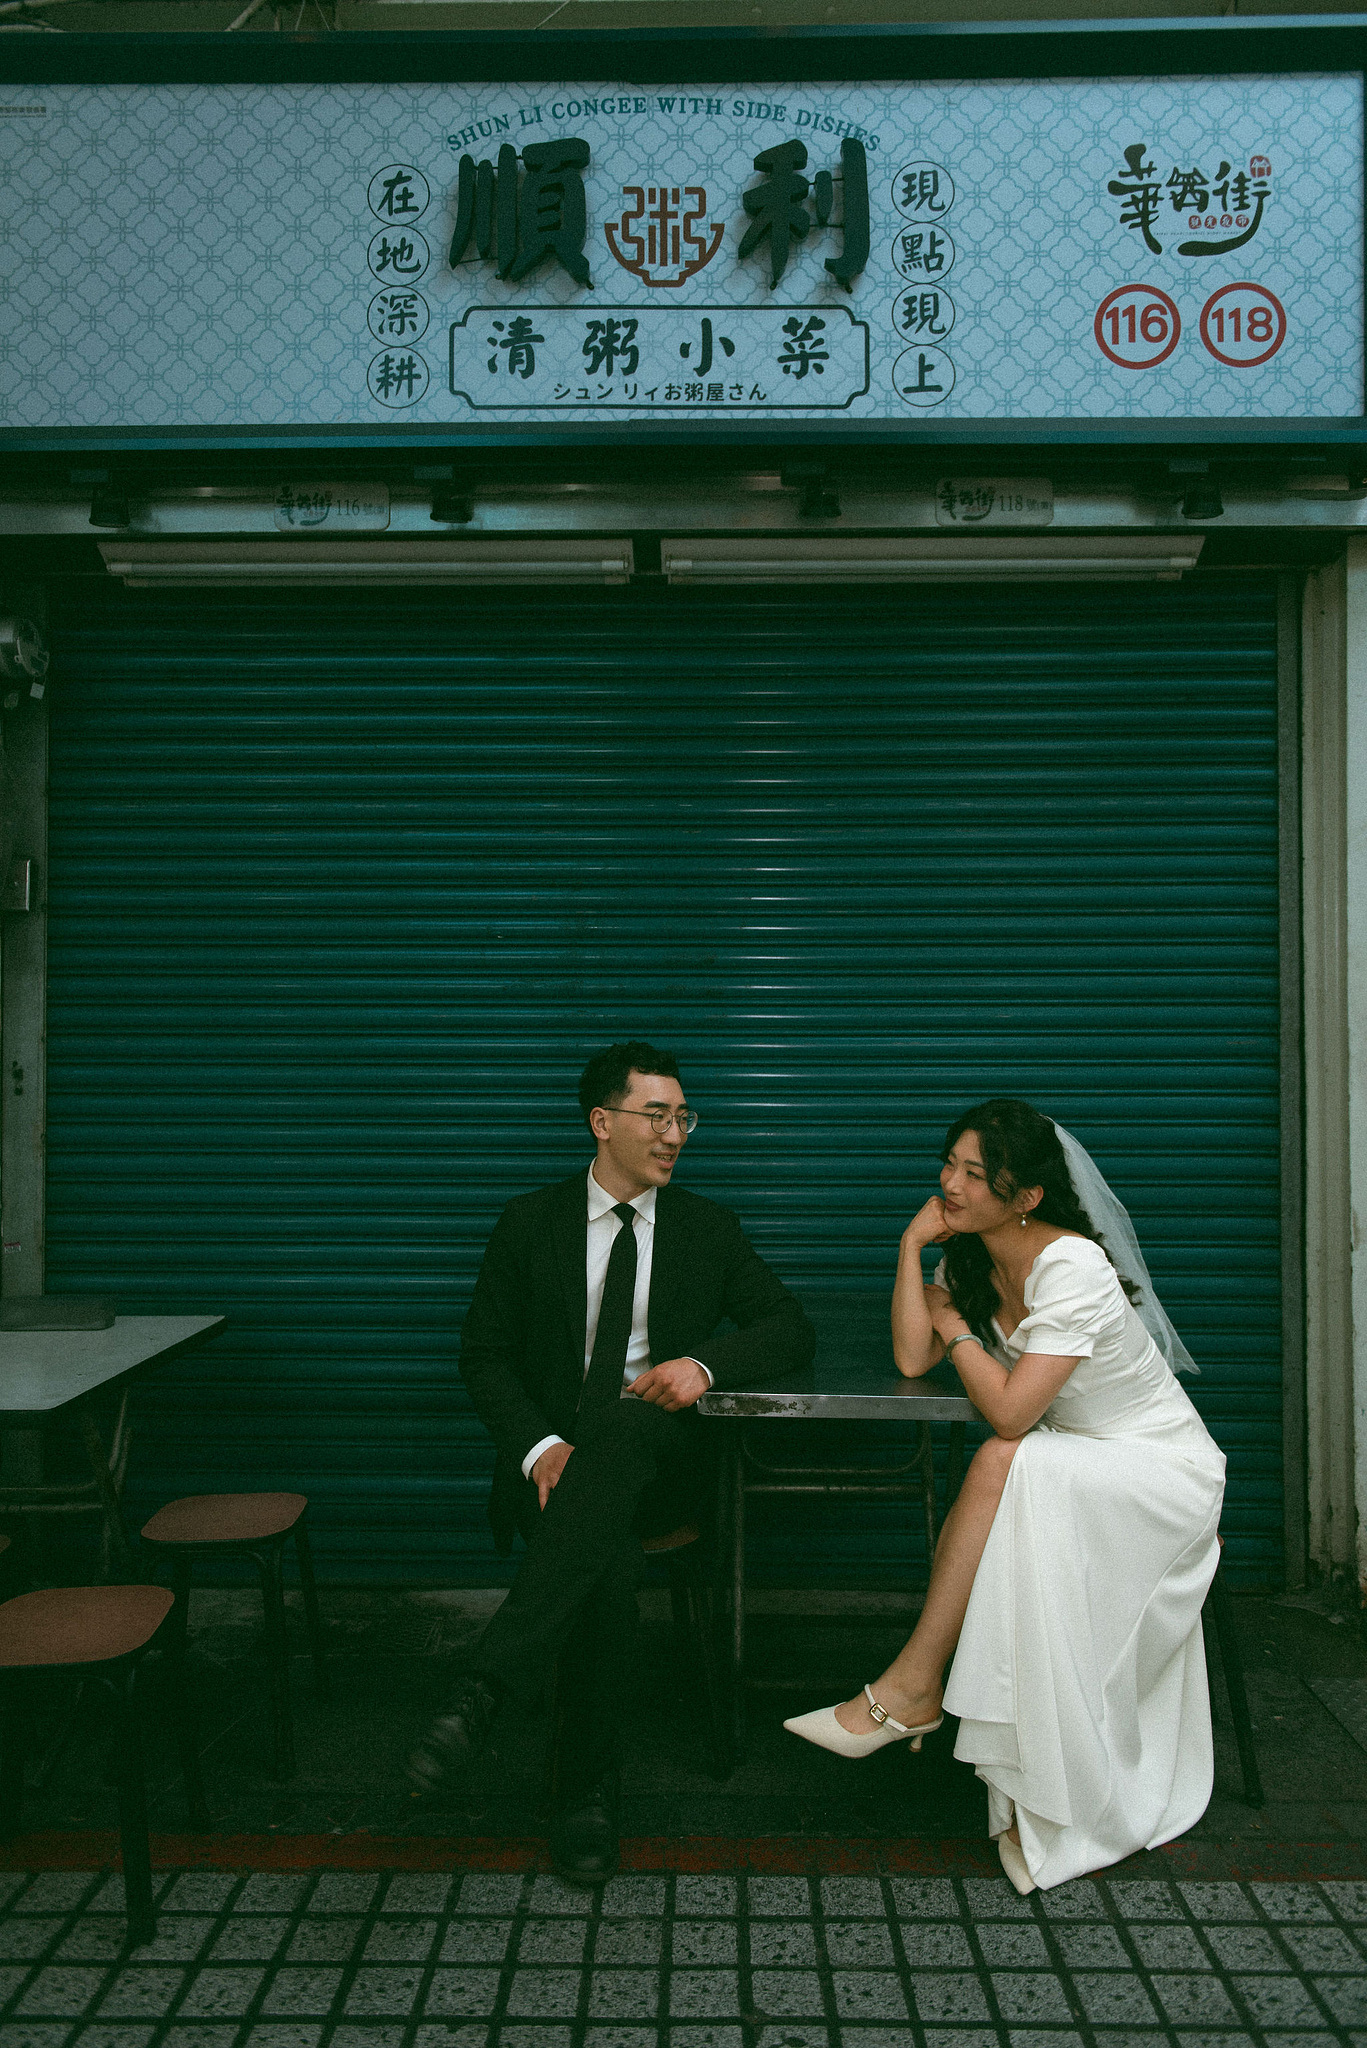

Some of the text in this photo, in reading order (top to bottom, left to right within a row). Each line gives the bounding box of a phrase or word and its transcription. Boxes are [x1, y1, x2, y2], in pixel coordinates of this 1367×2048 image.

[447, 97, 880, 151] SHUN LI CONGEE WITH SIDE DISHES
[375, 171, 422, 399] 在地深耕
[901, 170, 946, 394] 現點現上
[486, 315, 831, 380] 清粥小菜
[1105, 304, 1273, 345] 116 118
[336, 498, 360, 516] 116
[999, 494, 1023, 512] 118
